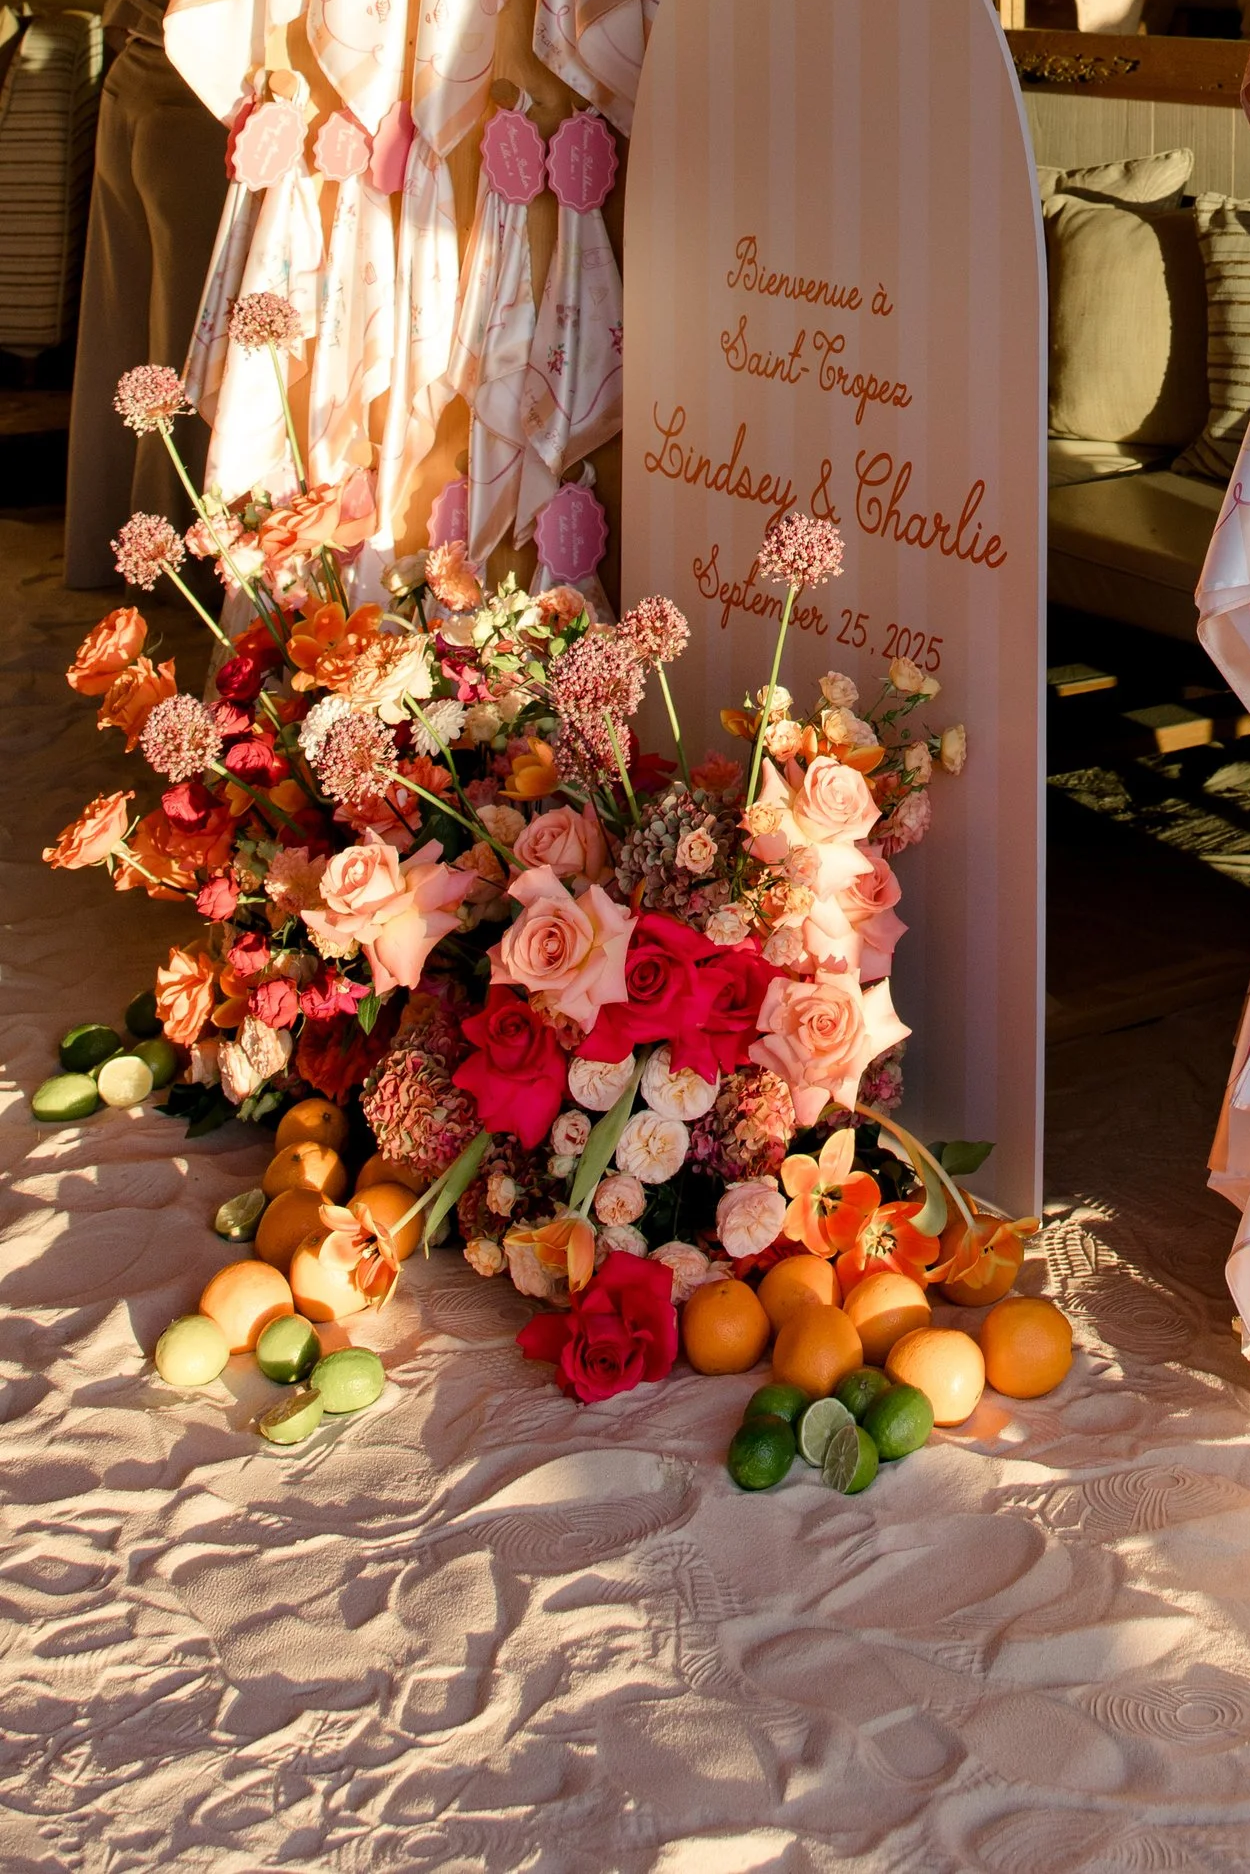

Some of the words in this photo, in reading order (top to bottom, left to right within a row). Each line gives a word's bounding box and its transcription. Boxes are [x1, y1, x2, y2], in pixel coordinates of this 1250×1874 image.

[727, 235, 863, 310] Bienvenue
[872, 283, 894, 317] à
[720, 314, 913, 425] Saint-Tropez
[644, 400, 798, 530] Lindsey
[811, 459, 842, 525] &
[855, 449, 1008, 569] Charlie
[836, 608, 875, 656] 25,
[882, 623, 945, 672] 2025
